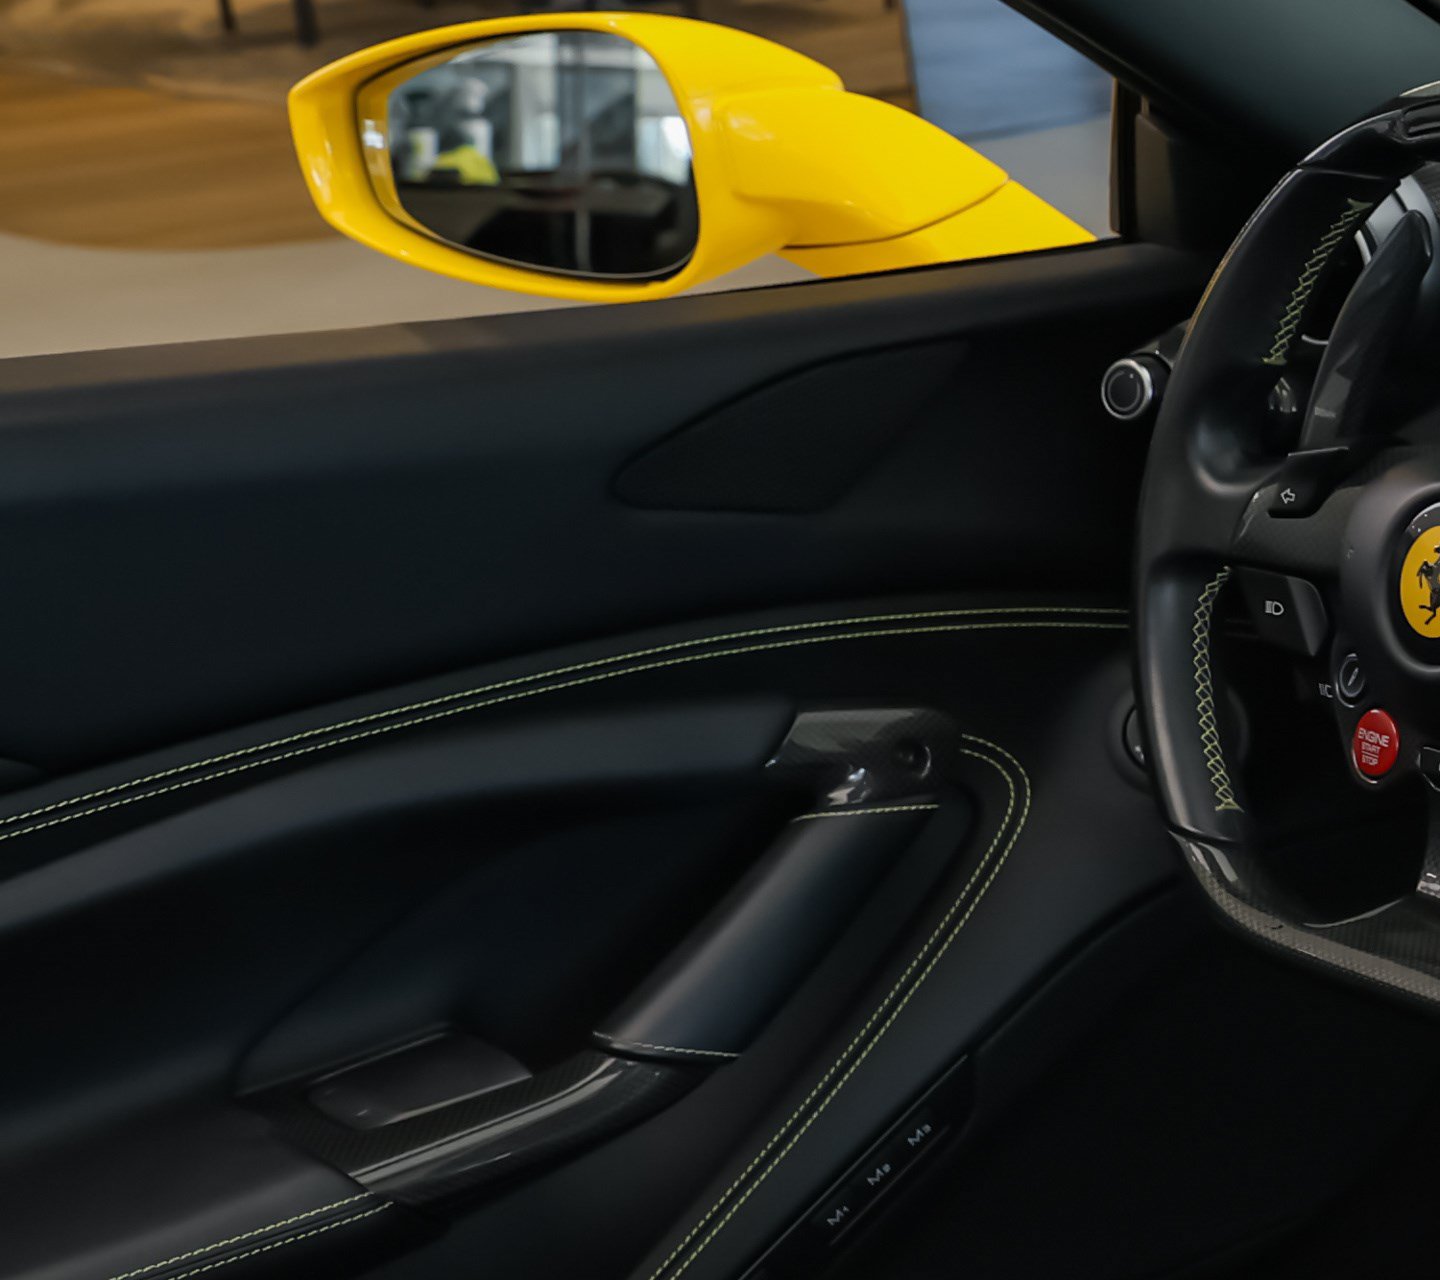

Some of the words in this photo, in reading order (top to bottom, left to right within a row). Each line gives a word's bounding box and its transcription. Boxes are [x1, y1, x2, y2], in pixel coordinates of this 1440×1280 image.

[1357, 727, 1390, 748] ENGINE
[1361, 741, 1380, 754] START
[1361, 754, 1379, 766] STOP
